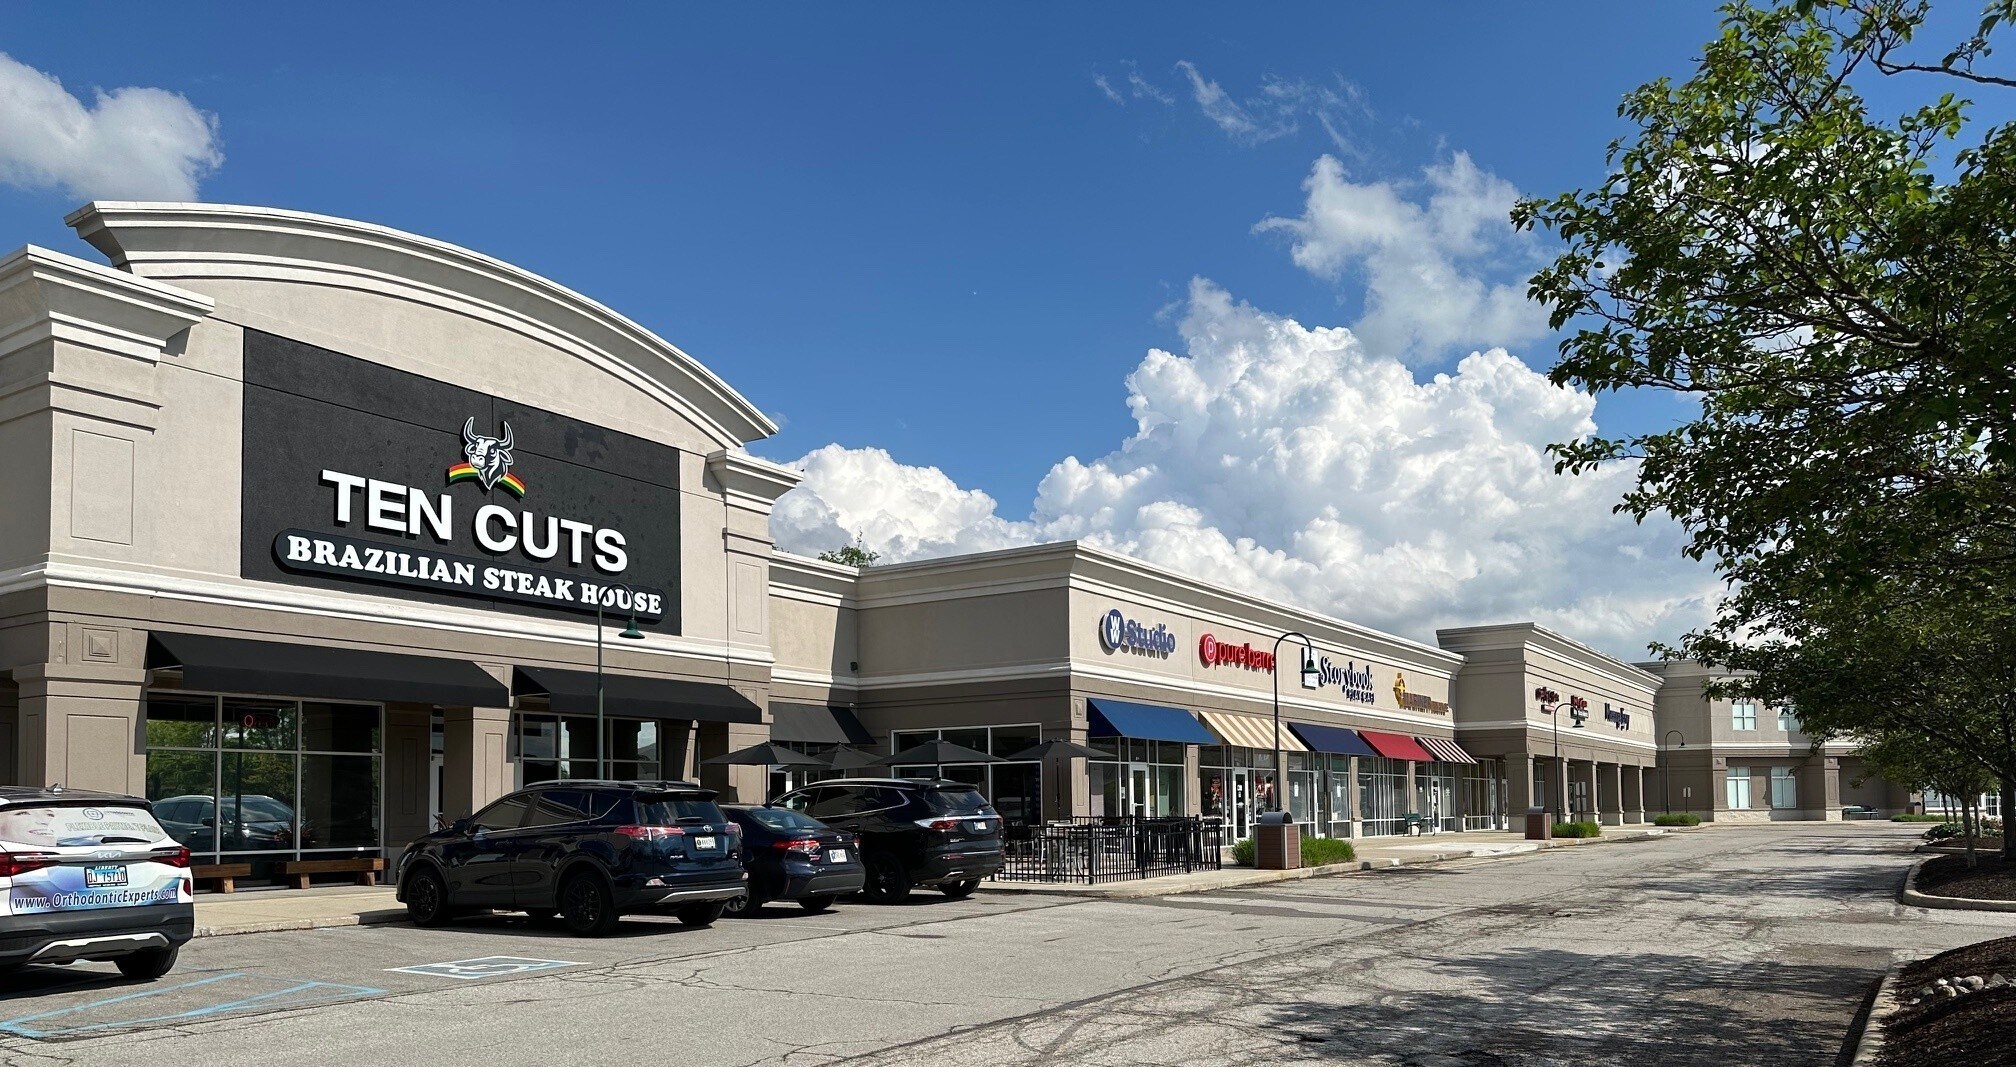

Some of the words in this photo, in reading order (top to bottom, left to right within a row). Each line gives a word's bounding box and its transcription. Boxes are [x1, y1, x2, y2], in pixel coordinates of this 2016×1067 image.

[322, 469, 452, 541] TEN
[475, 504, 628, 572] CUTS
[287, 535, 475, 587] BRAZILIAN
[483, 566, 574, 602] STEAK
[581, 583, 662, 615] HOUSE
[1127, 619, 1176, 653] Studio
[1217, 643, 1246, 665] pure
[1319, 656, 1373, 693] Storybook
